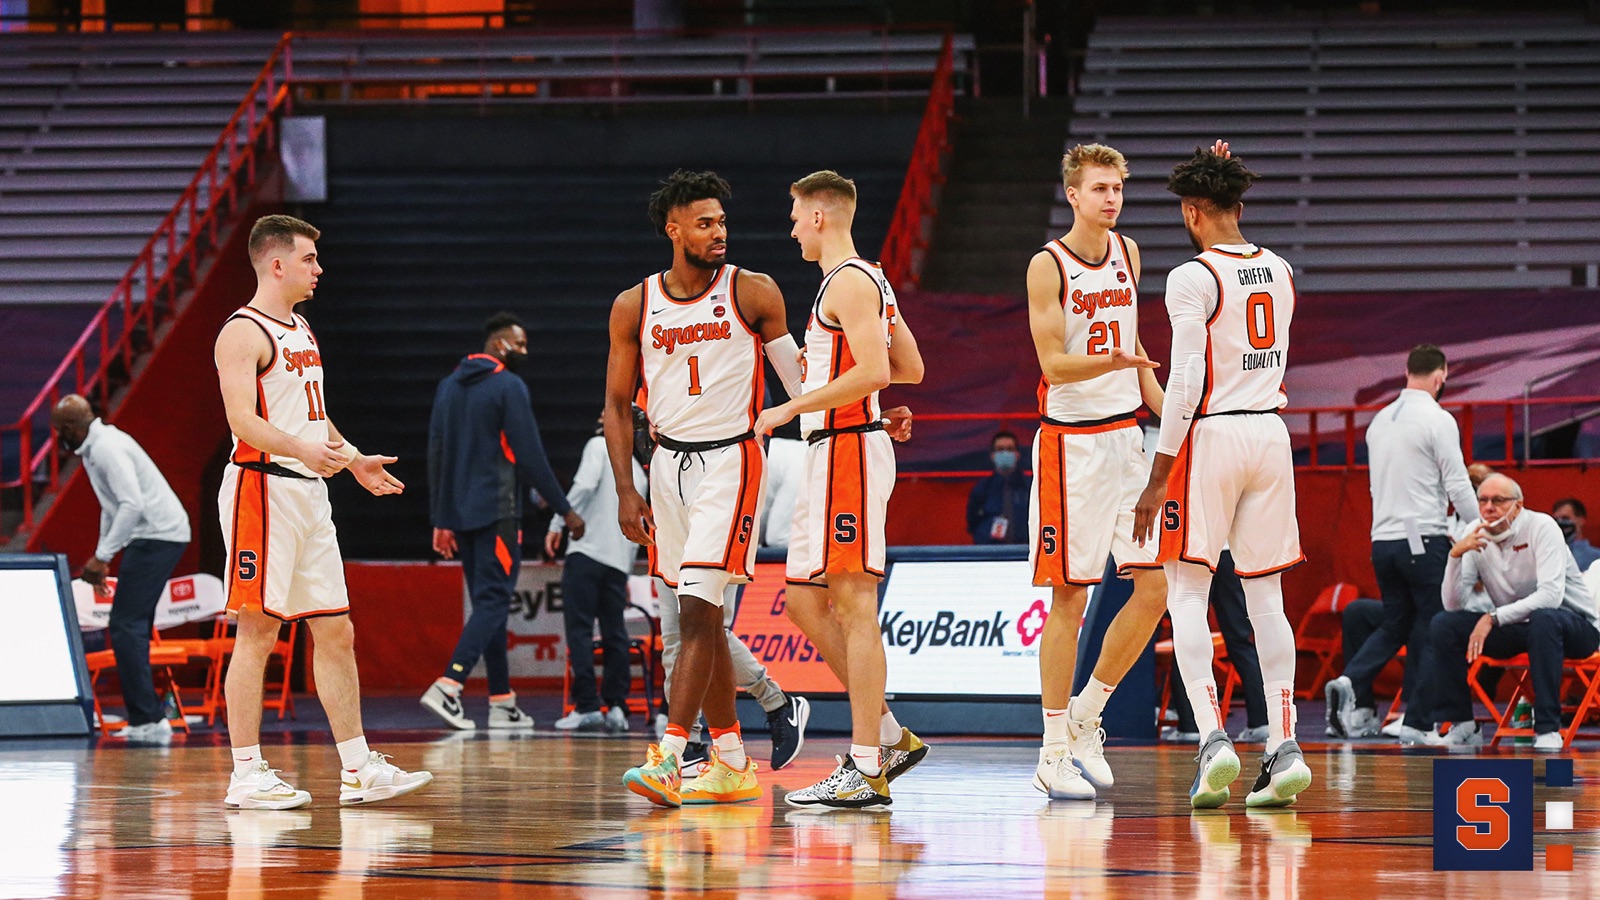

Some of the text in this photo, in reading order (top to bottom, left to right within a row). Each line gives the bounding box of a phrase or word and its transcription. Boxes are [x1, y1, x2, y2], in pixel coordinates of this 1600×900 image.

[1237, 267, 1274, 286] GRIFFIN
[1246, 291, 1276, 350] 0
[651, 320, 732, 355] Syracuse
[1087, 320, 1121, 355] 21
[687, 355, 702, 396] 1
[1242, 350, 1281, 371] EQUALITY
[304, 381, 325, 421] 11
[834, 513, 858, 544] S
[1164, 500, 1181, 531] S
[1042, 525, 1058, 556] S
[238, 549, 258, 581] S
[880, 611, 1010, 655] KeyBank
